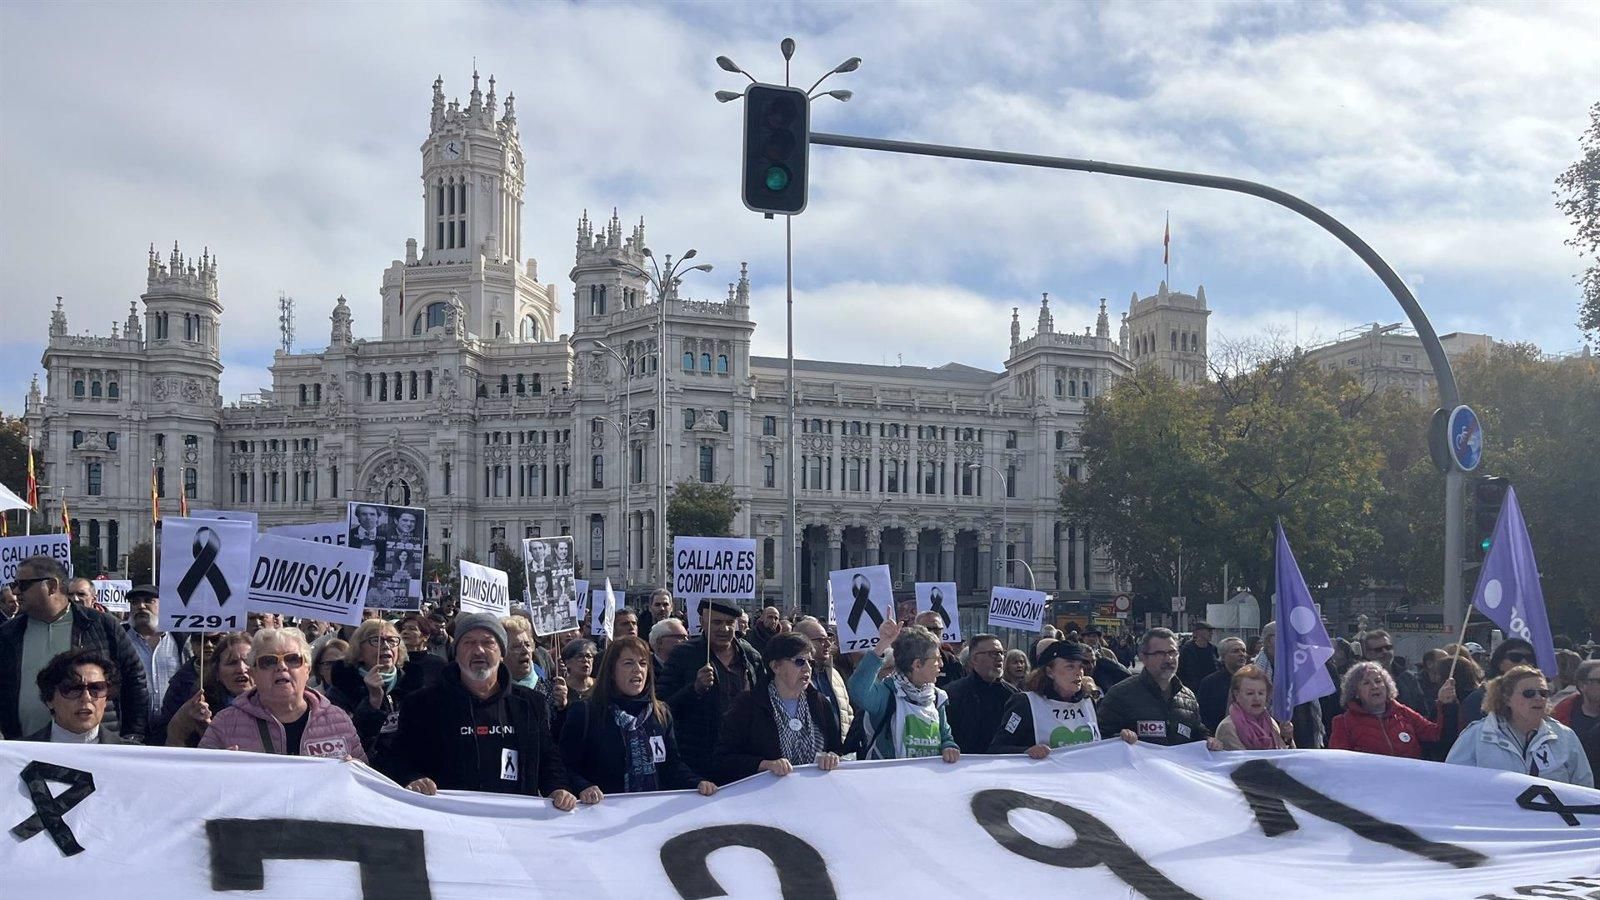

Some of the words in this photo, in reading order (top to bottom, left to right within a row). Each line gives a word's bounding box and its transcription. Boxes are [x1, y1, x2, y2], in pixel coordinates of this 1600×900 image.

[53, 543, 68, 558] ES
[677, 549, 733, 570] CALLAR
[736, 551, 755, 570] ES
[250, 556, 366, 605] DIMISIÓN!
[677, 573, 754, 593] COMPLICIDAD
[462, 575, 507, 607] DIMISIÓN!
[991, 597, 1043, 620] DIMISIÓN!
[171, 614, 237, 628] 7291
[847, 637, 880, 650] 729
[942, 633, 956, 641] 91
[1053, 708, 1084, 720] 7291
[1140, 723, 1164, 732] NO+
[308, 741, 343, 756] NO+
